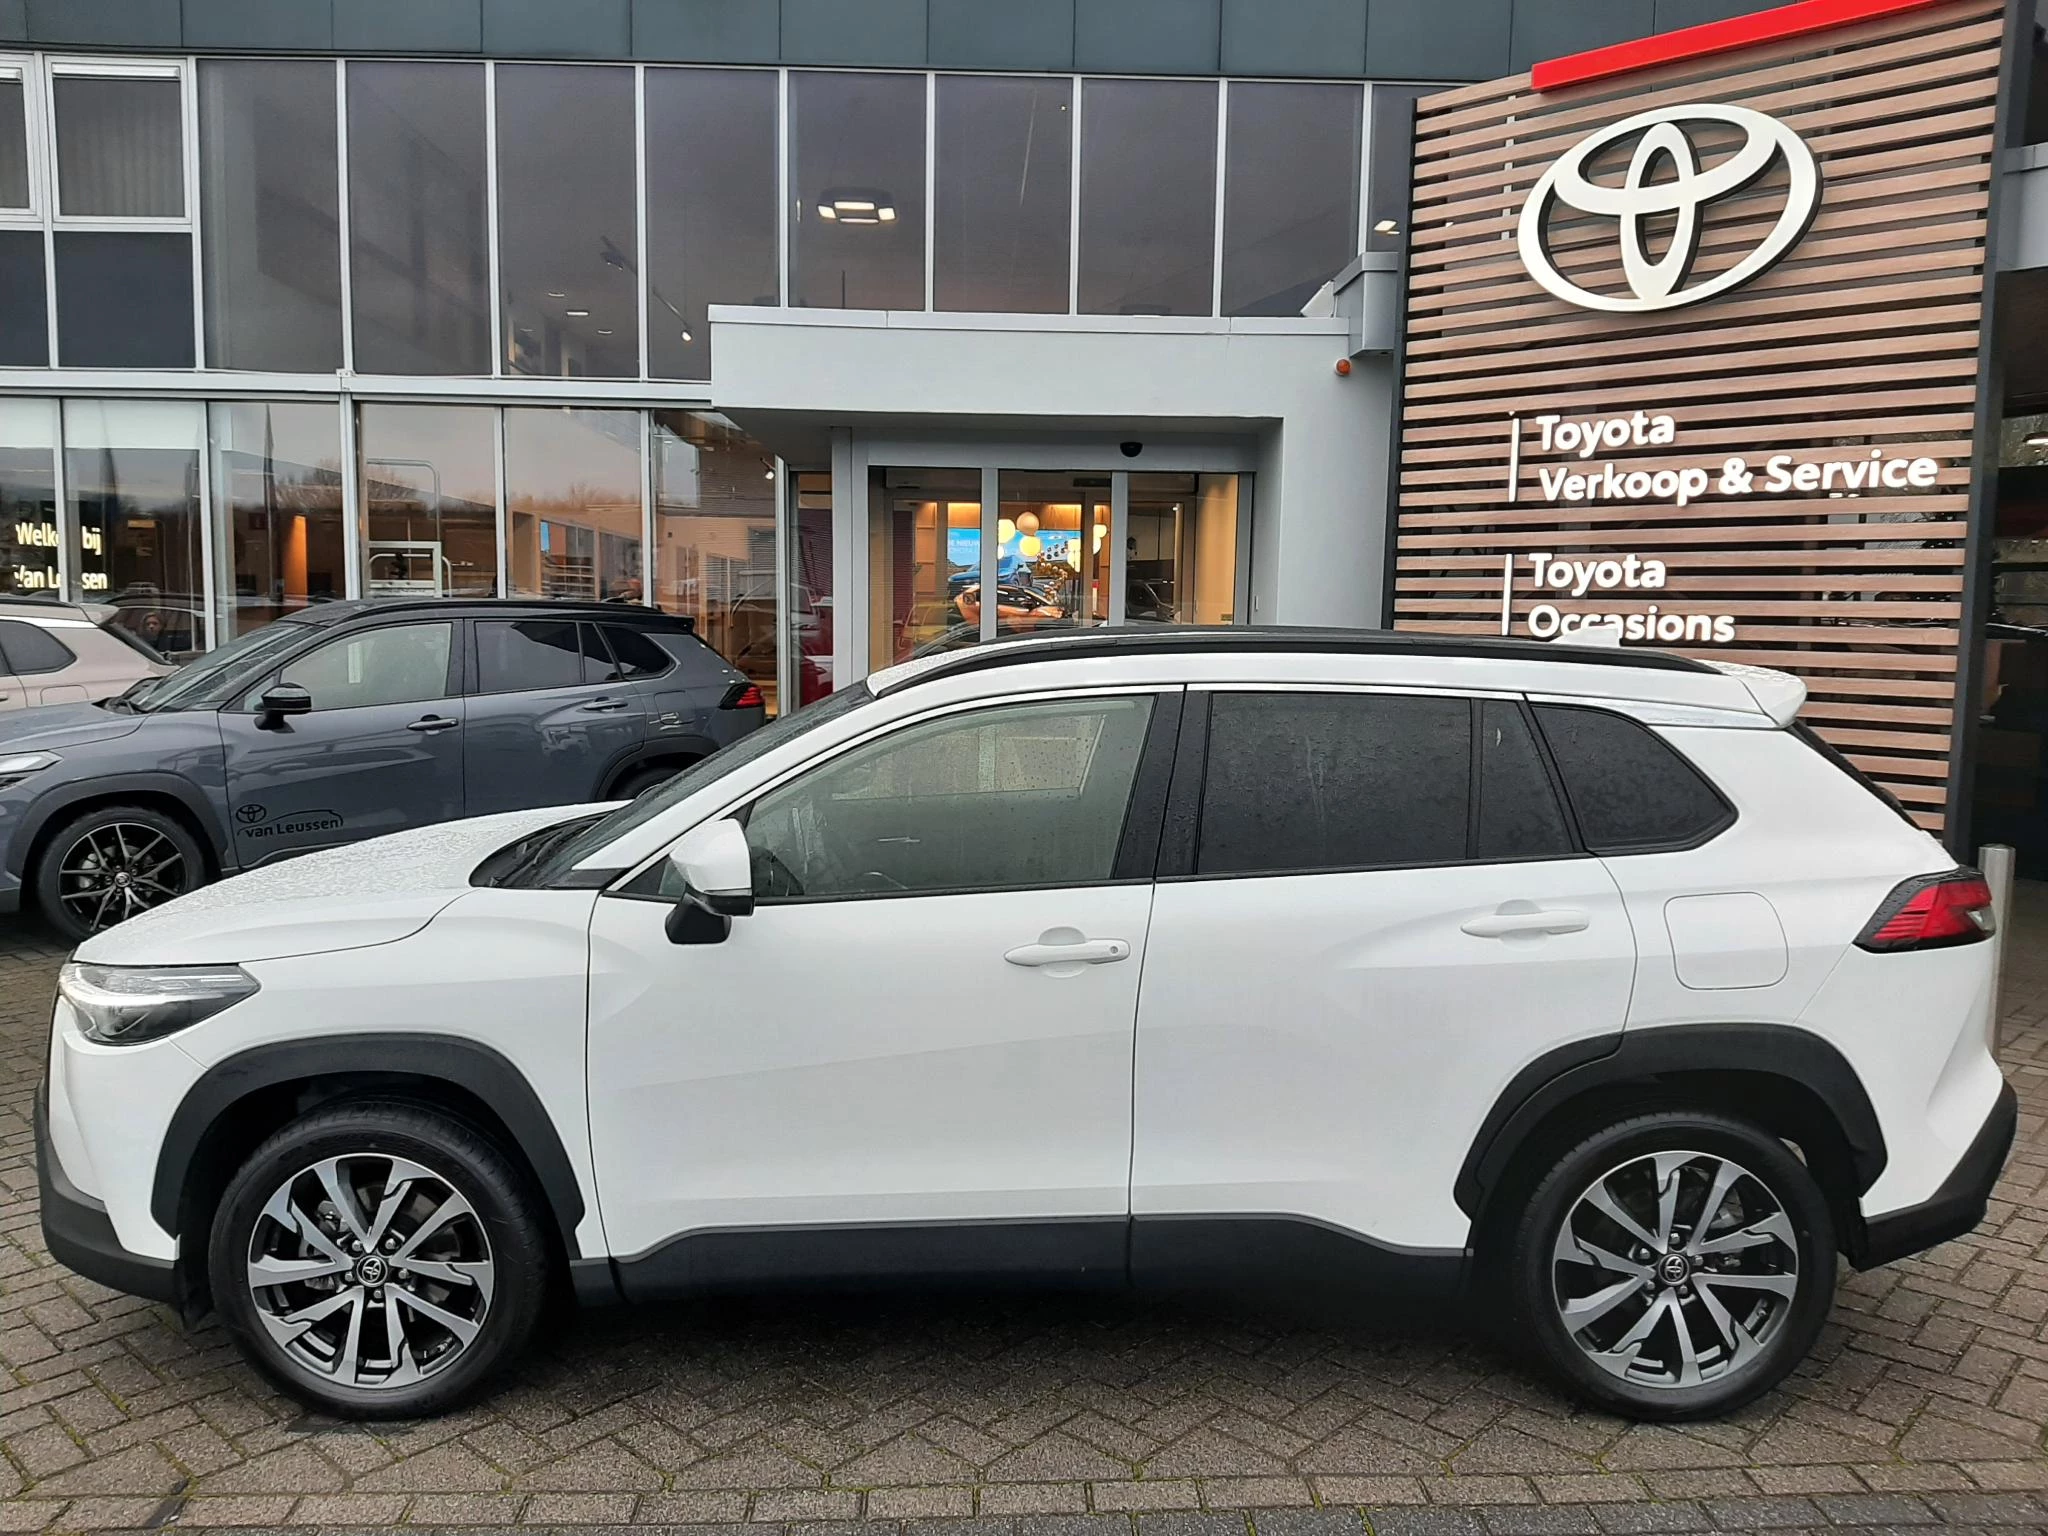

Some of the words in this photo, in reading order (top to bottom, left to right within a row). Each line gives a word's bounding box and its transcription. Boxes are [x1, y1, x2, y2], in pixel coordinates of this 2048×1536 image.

[1535, 410, 1675, 458] Toyota
[1538, 462, 1708, 506] Verkoop
[1718, 457, 1753, 495] &
[1765, 449, 1938, 492] Service
[15, 522, 60, 547] Welk
[81, 525, 102, 555] bij
[48, 565, 108, 589] Lesen
[1528, 553, 1667, 597] Toyota
[245, 826, 273, 838] van
[276, 819, 339, 835] Leussen
